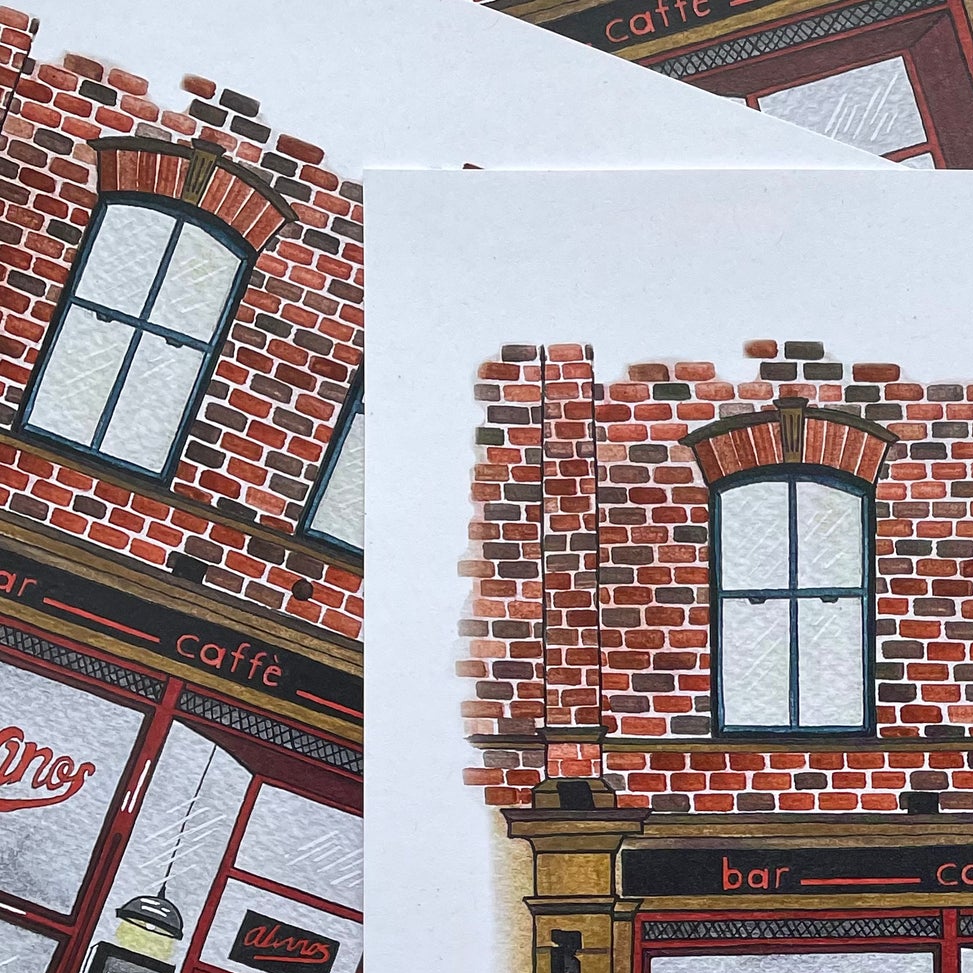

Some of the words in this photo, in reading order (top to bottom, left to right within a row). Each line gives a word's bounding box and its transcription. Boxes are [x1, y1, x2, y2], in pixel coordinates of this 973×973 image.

[0, 570, 38, 597] ar
[175, 634, 283, 687] caffè
[722, 856, 790, 890] bar
